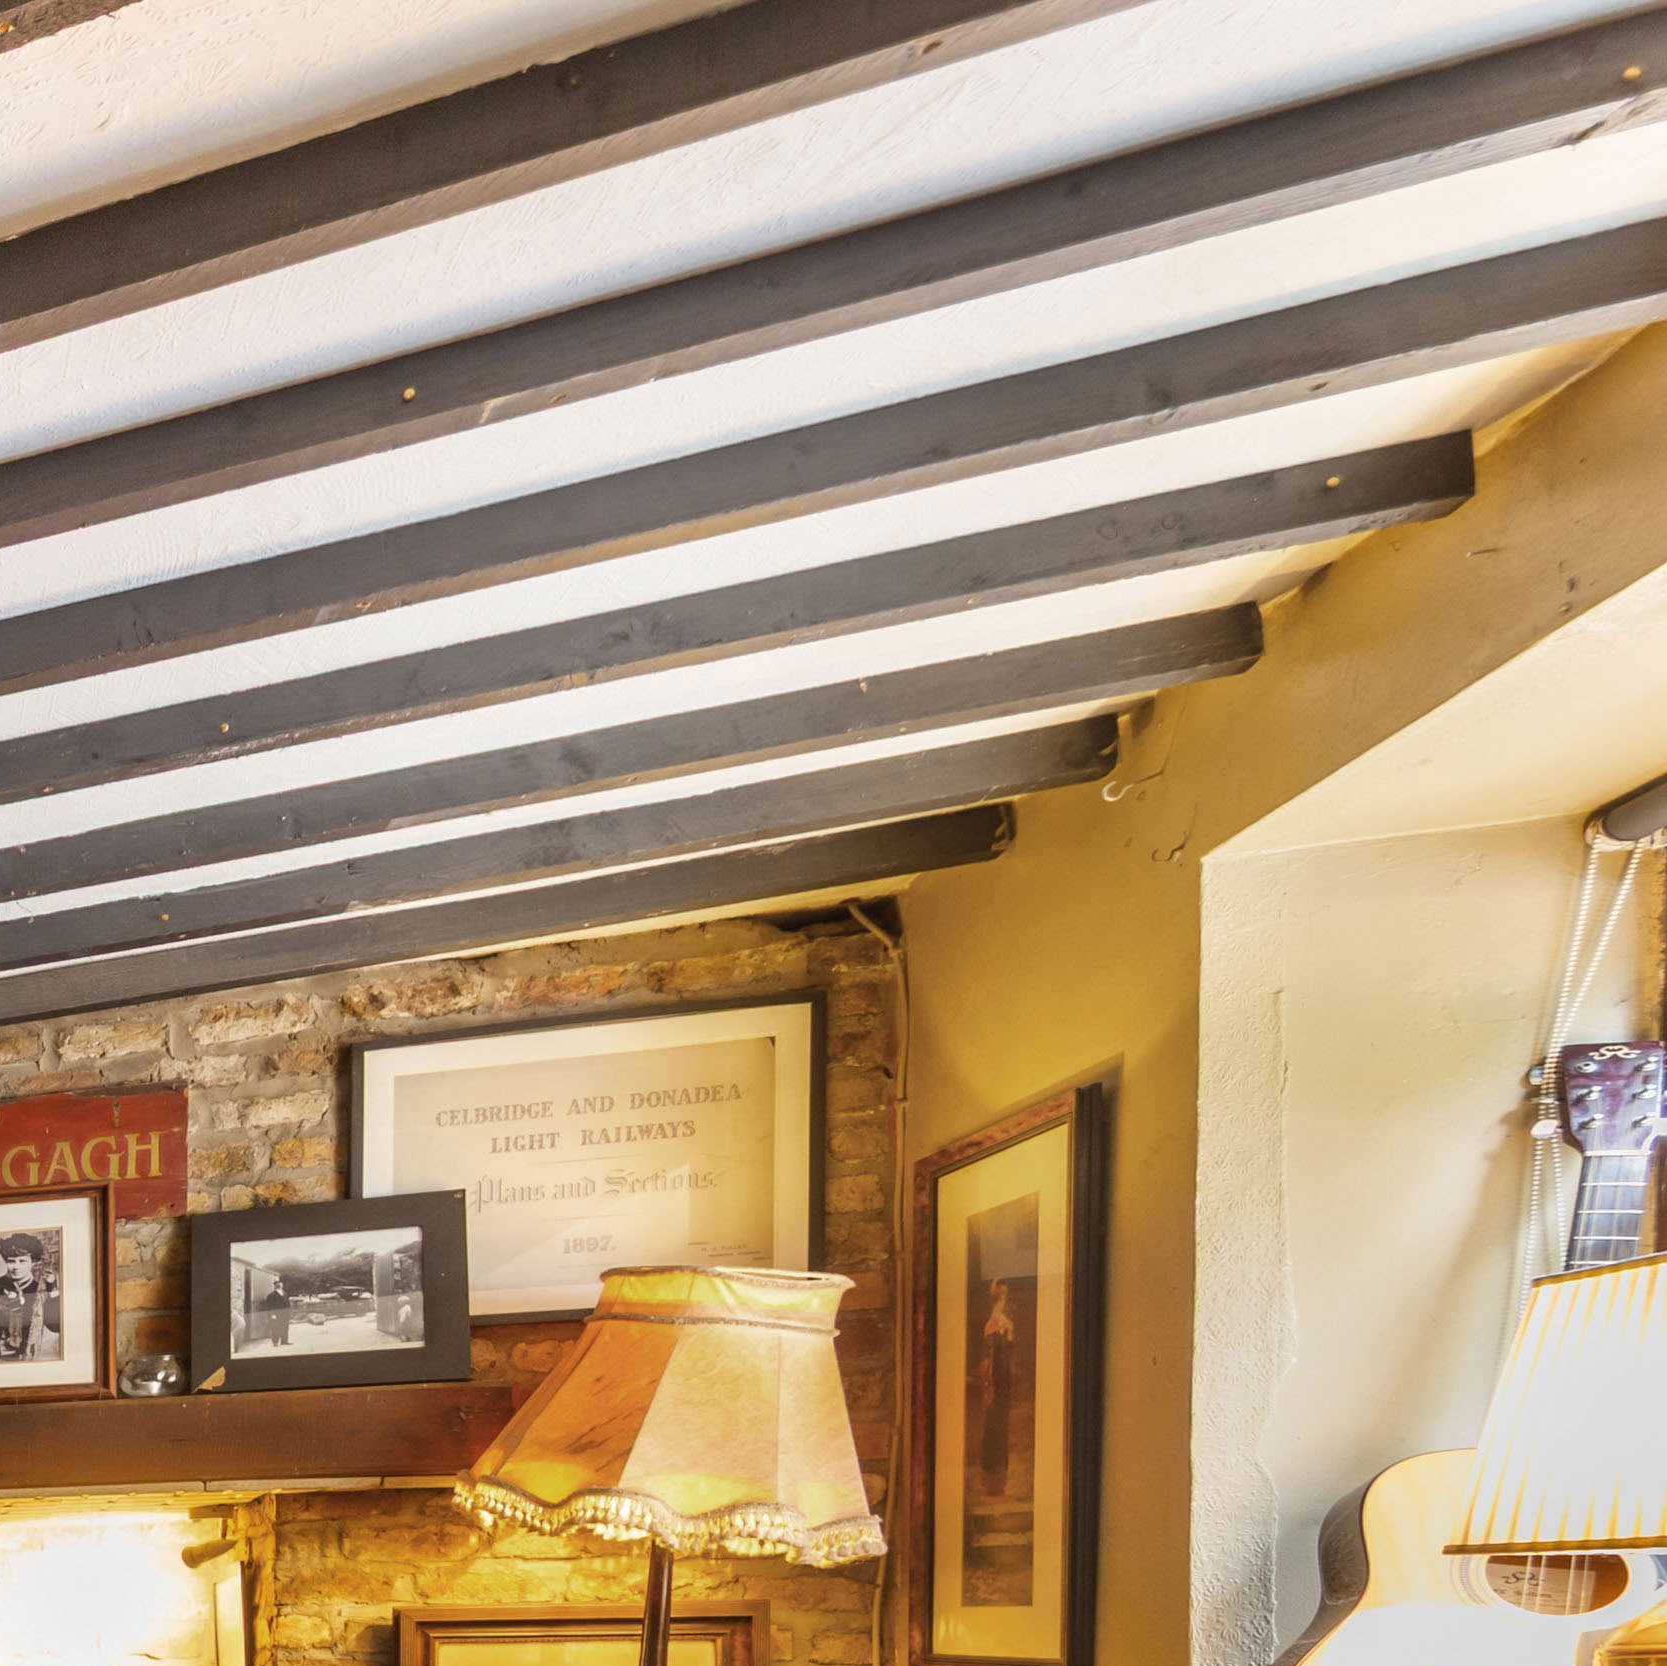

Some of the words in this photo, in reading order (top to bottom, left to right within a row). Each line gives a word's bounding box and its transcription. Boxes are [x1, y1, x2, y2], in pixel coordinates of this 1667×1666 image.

[435, 1101, 554, 1128] CELBRIDGE
[566, 1095, 615, 1116] AND
[490, 1132, 560, 1155] LIGHT
[580, 1120, 697, 1147] RAILWAYS
[469, 1174, 546, 1213] Plans
[552, 1175, 596, 1201] and
